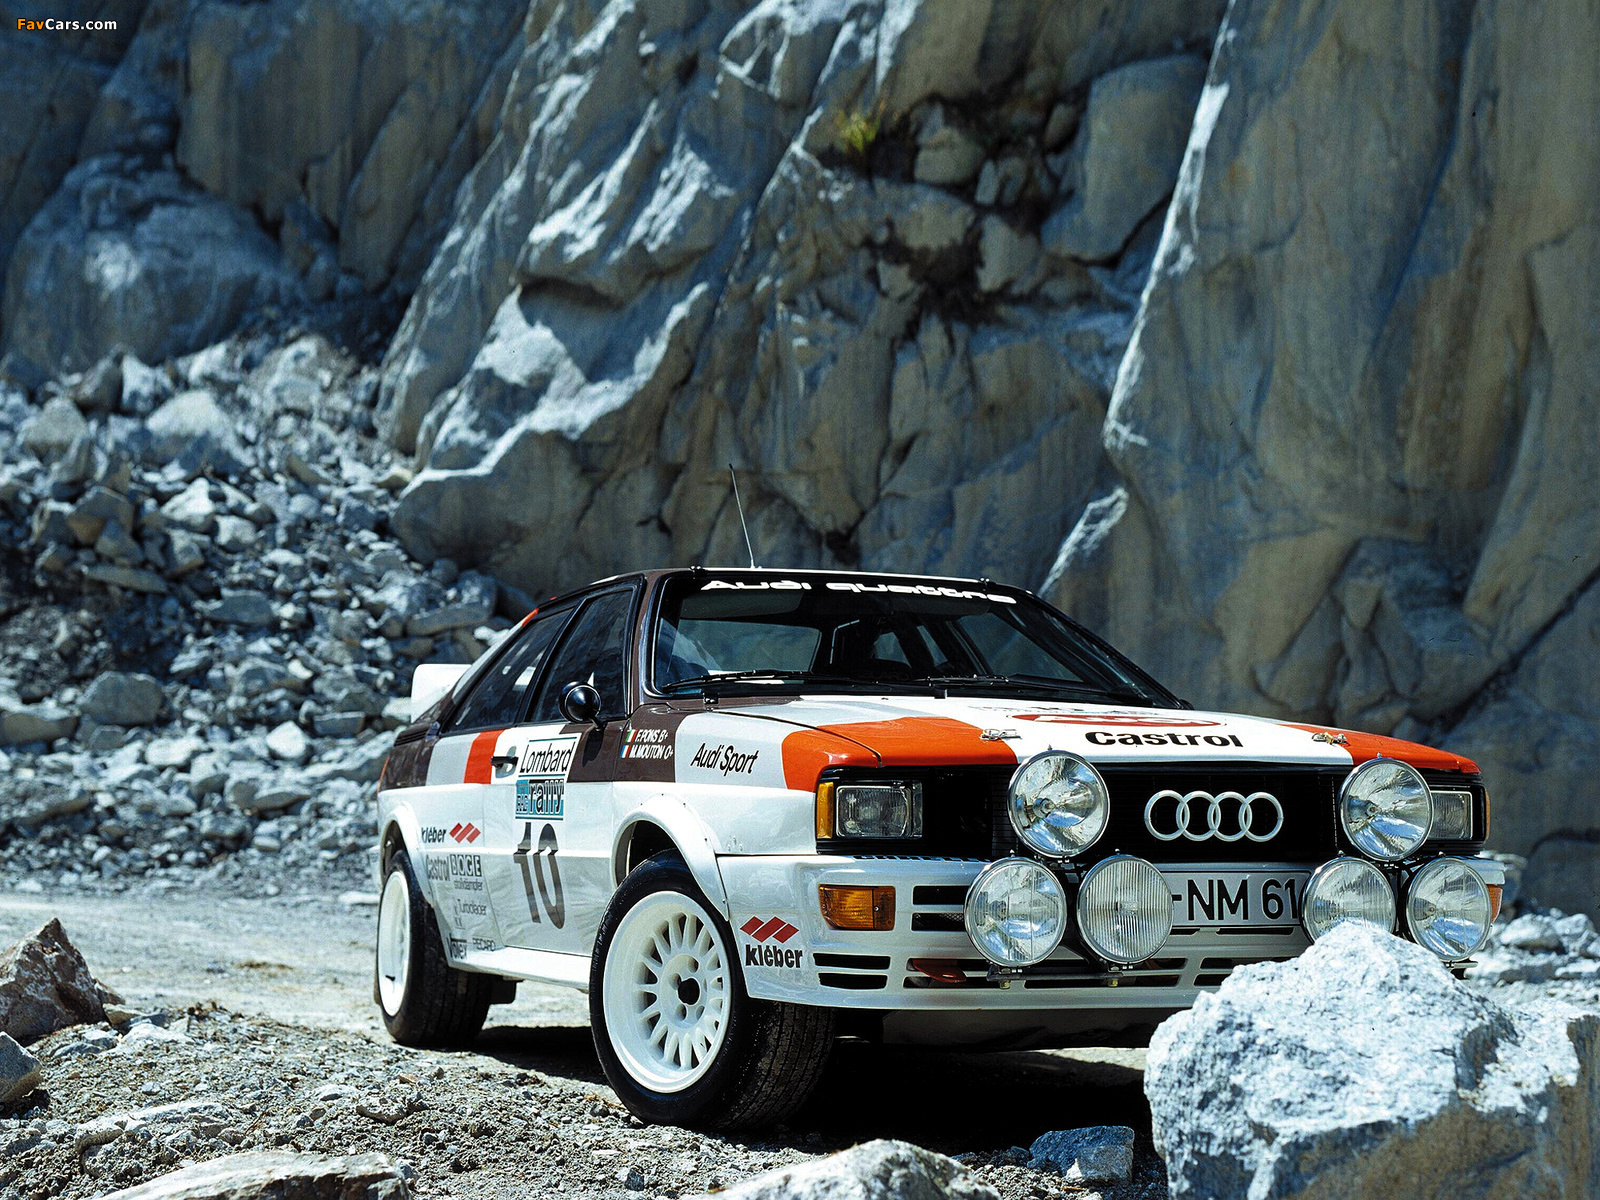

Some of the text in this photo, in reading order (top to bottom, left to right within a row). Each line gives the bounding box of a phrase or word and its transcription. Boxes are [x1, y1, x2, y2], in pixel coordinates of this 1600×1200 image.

[701, 580, 1017, 604] Audi quattro
[1085, 731, 1243, 748] Castrol
[520, 741, 576, 774] Lombard
[690, 743, 759, 777] Audi Sport
[530, 780, 564, 815] rally
[450, 854, 482, 877] BOGE
[513, 822, 565, 929] 10
[1262, 878, 1298, 920] 61
[745, 944, 803, 968] kléber
